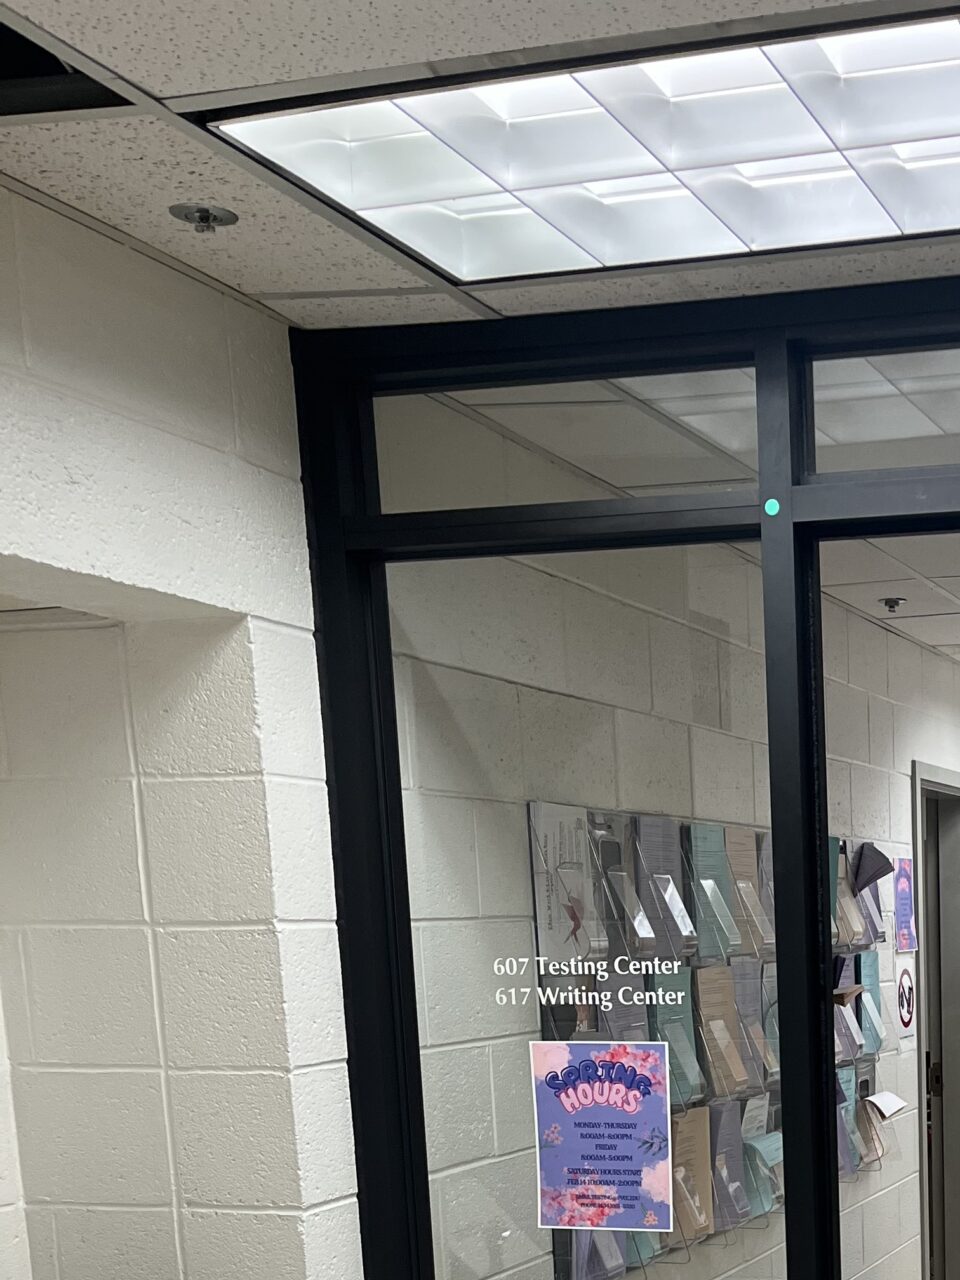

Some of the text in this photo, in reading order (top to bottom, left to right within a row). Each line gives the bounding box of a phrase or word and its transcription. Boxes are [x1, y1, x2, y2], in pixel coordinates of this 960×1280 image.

[493, 956, 682, 981] 607 Testing Center
[495, 987, 531, 1006] 617
[536, 986, 612, 1011] Writing
[618, 986, 685, 1006] Center
[545, 1059, 652, 1099] SPRING
[558, 1079, 643, 1115] HOURS
[595, 1143, 618, 1151] FRIDAY
[567, 1167, 599, 1176] SATURDAY
[600, 1168, 622, 1176] HOURS
